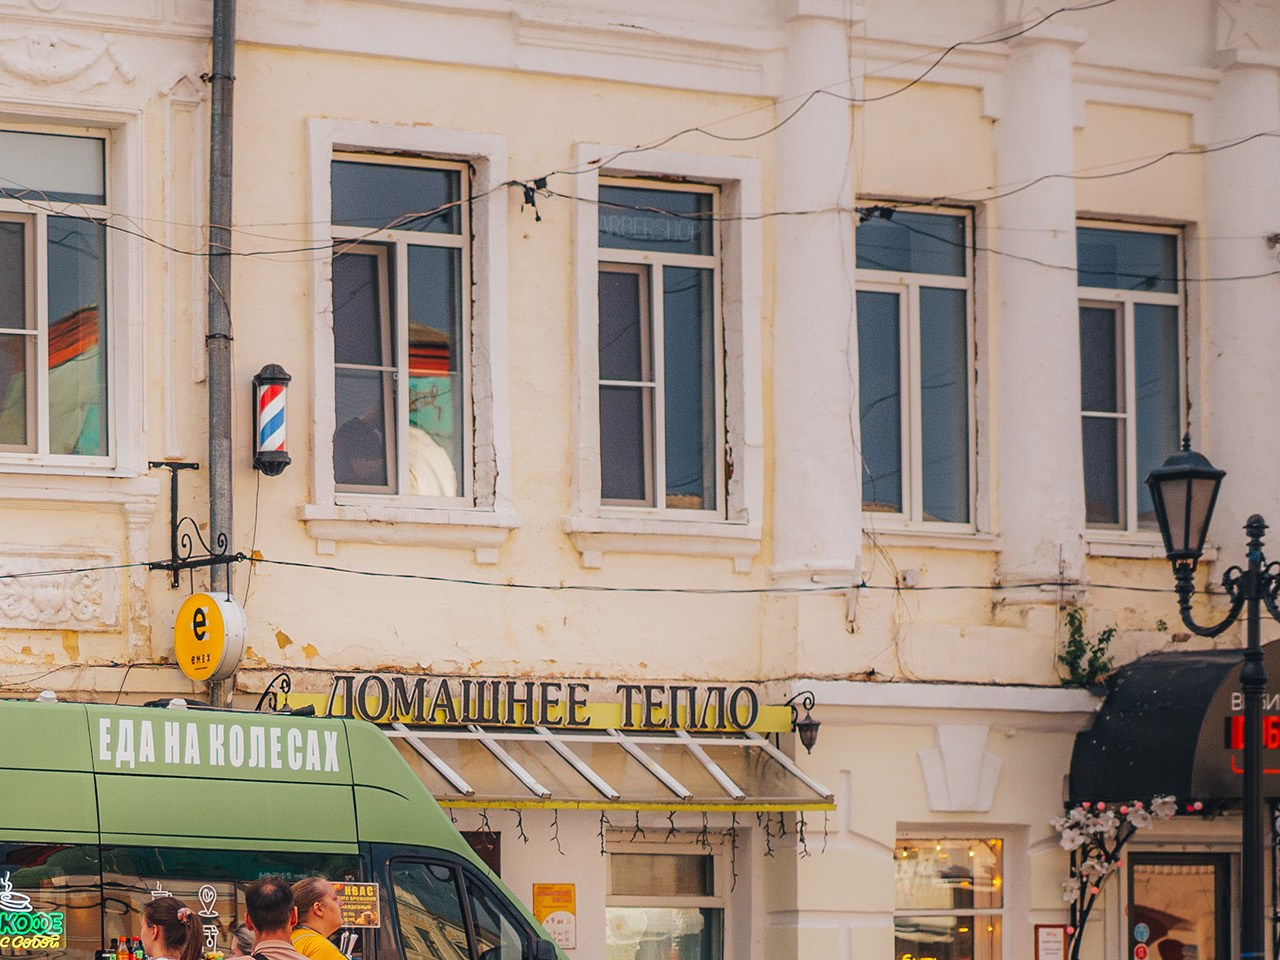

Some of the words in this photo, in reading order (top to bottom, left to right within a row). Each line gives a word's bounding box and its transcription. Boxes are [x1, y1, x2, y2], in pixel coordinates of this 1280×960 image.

[323, 674, 592, 728] ДОМАШНЕЕ
[616, 683, 759, 732] ТЕПЛО
[99, 718, 155, 768] ЕДА
[164, 721, 201, 764] НА
[209, 723, 339, 772] КОЛЕСАХ
